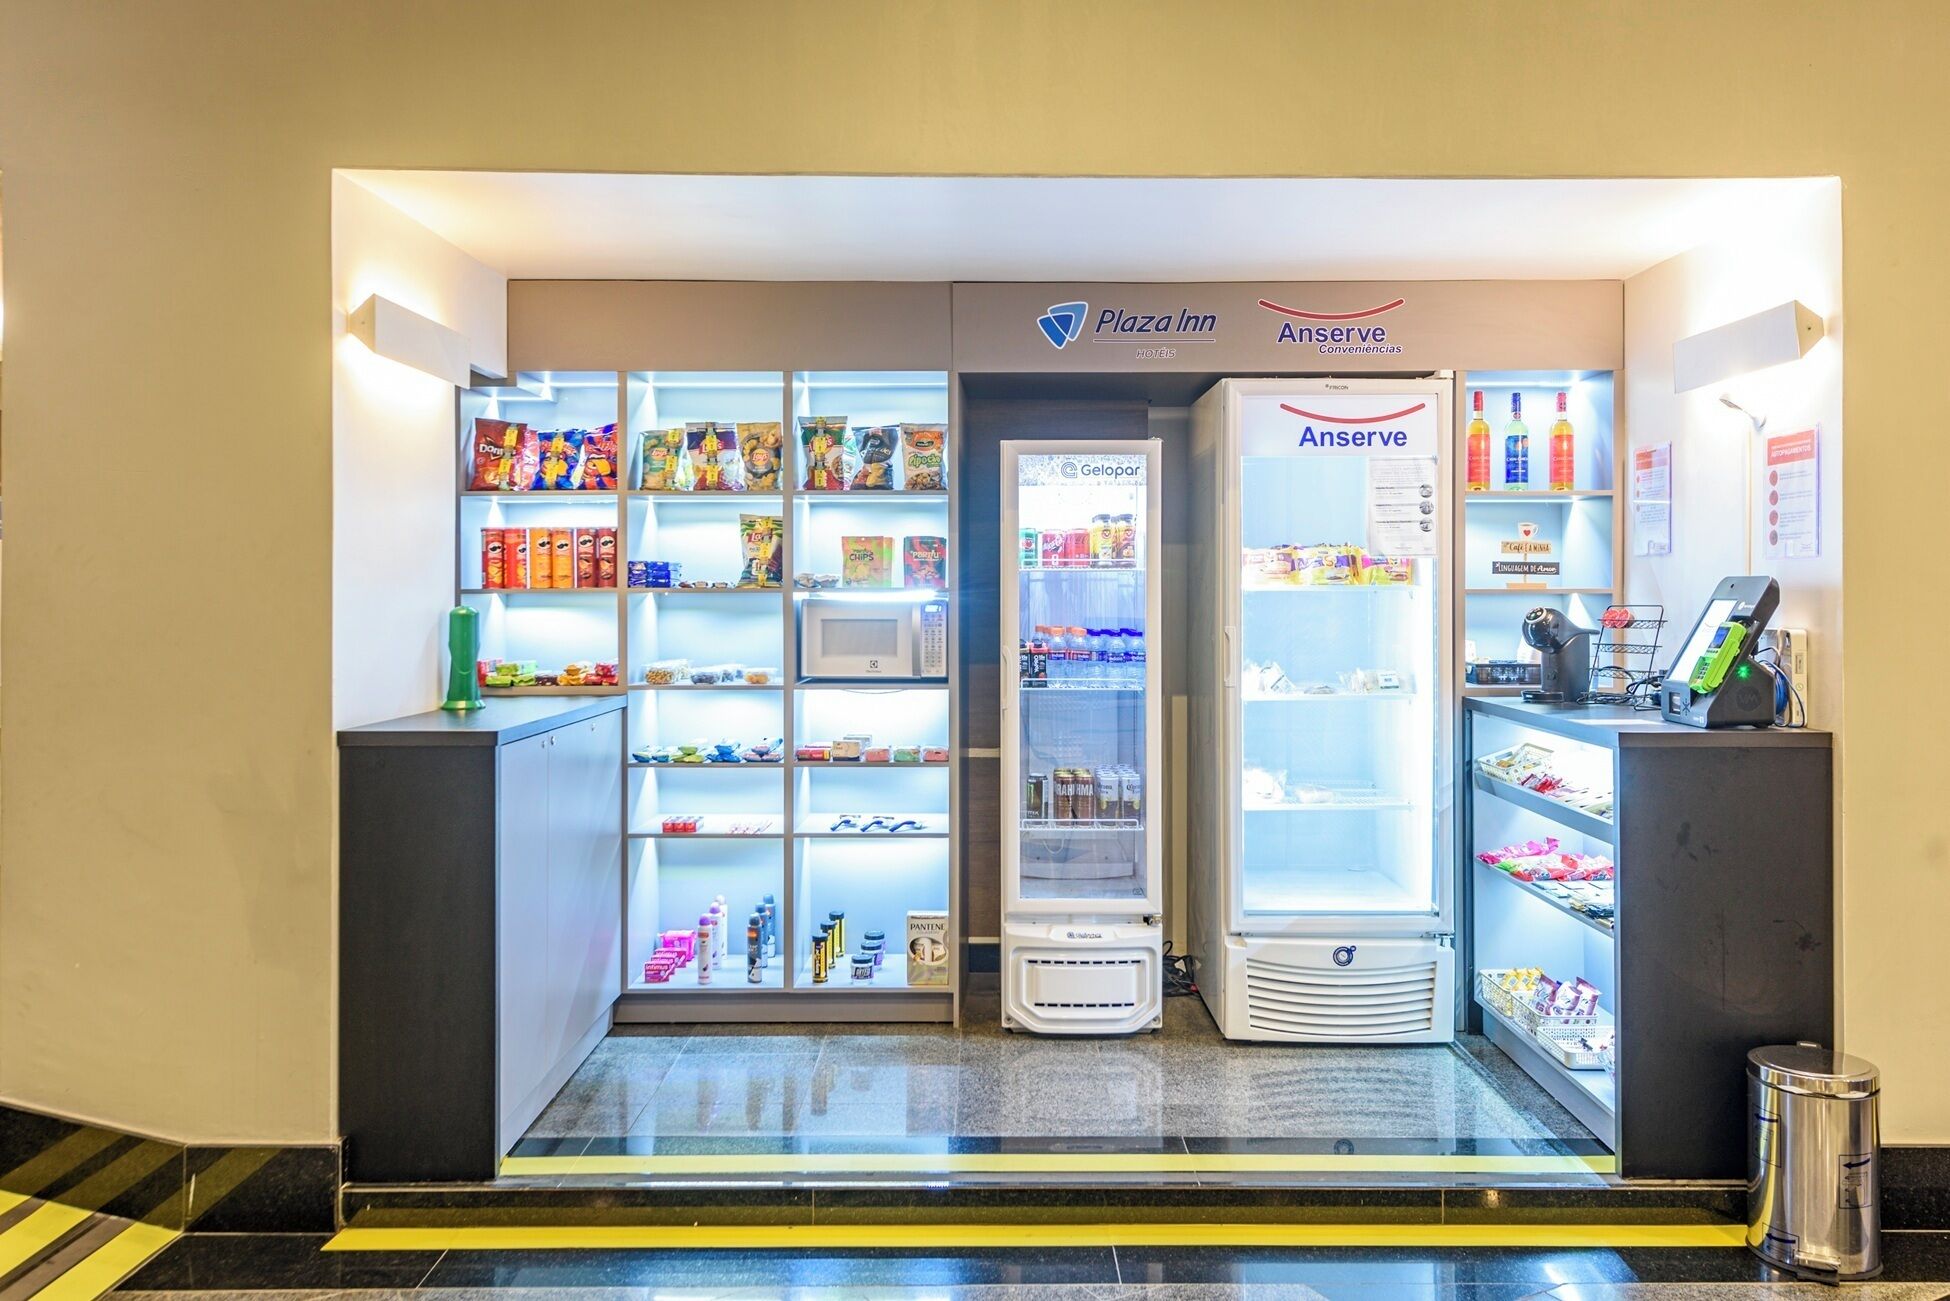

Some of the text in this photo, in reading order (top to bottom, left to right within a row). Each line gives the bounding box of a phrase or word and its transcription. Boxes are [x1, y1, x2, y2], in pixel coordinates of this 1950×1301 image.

[1095, 308, 1217, 333] Plaza Inn
[1277, 322, 1386, 343] Anserve
[1136, 347, 1176, 359] HOTÉIS
[1319, 344, 1402, 354] Conveniências
[1298, 426, 1408, 447] Anserve
[1080, 464, 1141, 479] Gelopar
[1509, 542, 1523, 553] Café
[1498, 562, 1529, 572] LINGUAGEM
[910, 923, 945, 931] PANTENE
